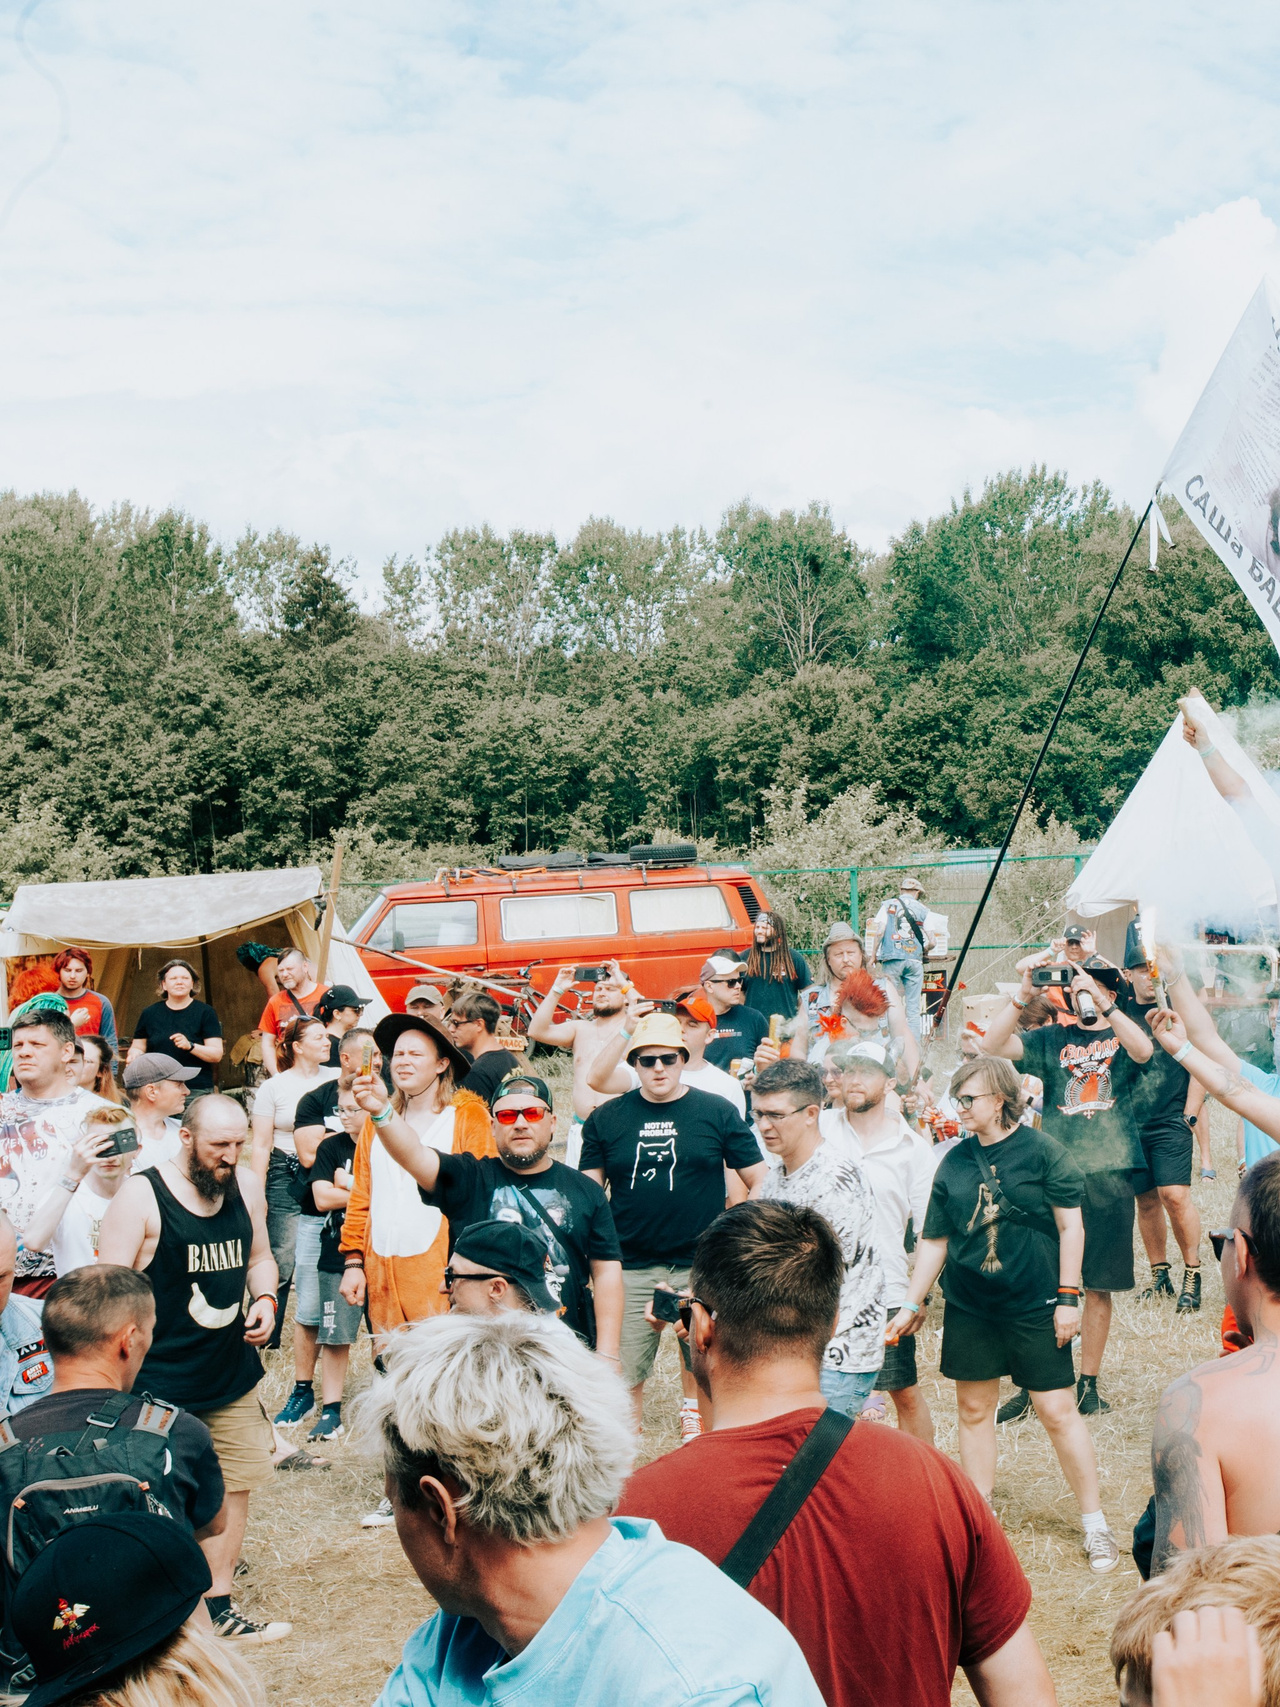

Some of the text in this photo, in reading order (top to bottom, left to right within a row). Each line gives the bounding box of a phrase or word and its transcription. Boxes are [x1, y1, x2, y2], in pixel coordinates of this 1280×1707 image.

[644, 1121, 674, 1130] NOT MY
[639, 1129, 678, 1137] PROBLEM.
[187, 1239, 243, 1273] BANANA
